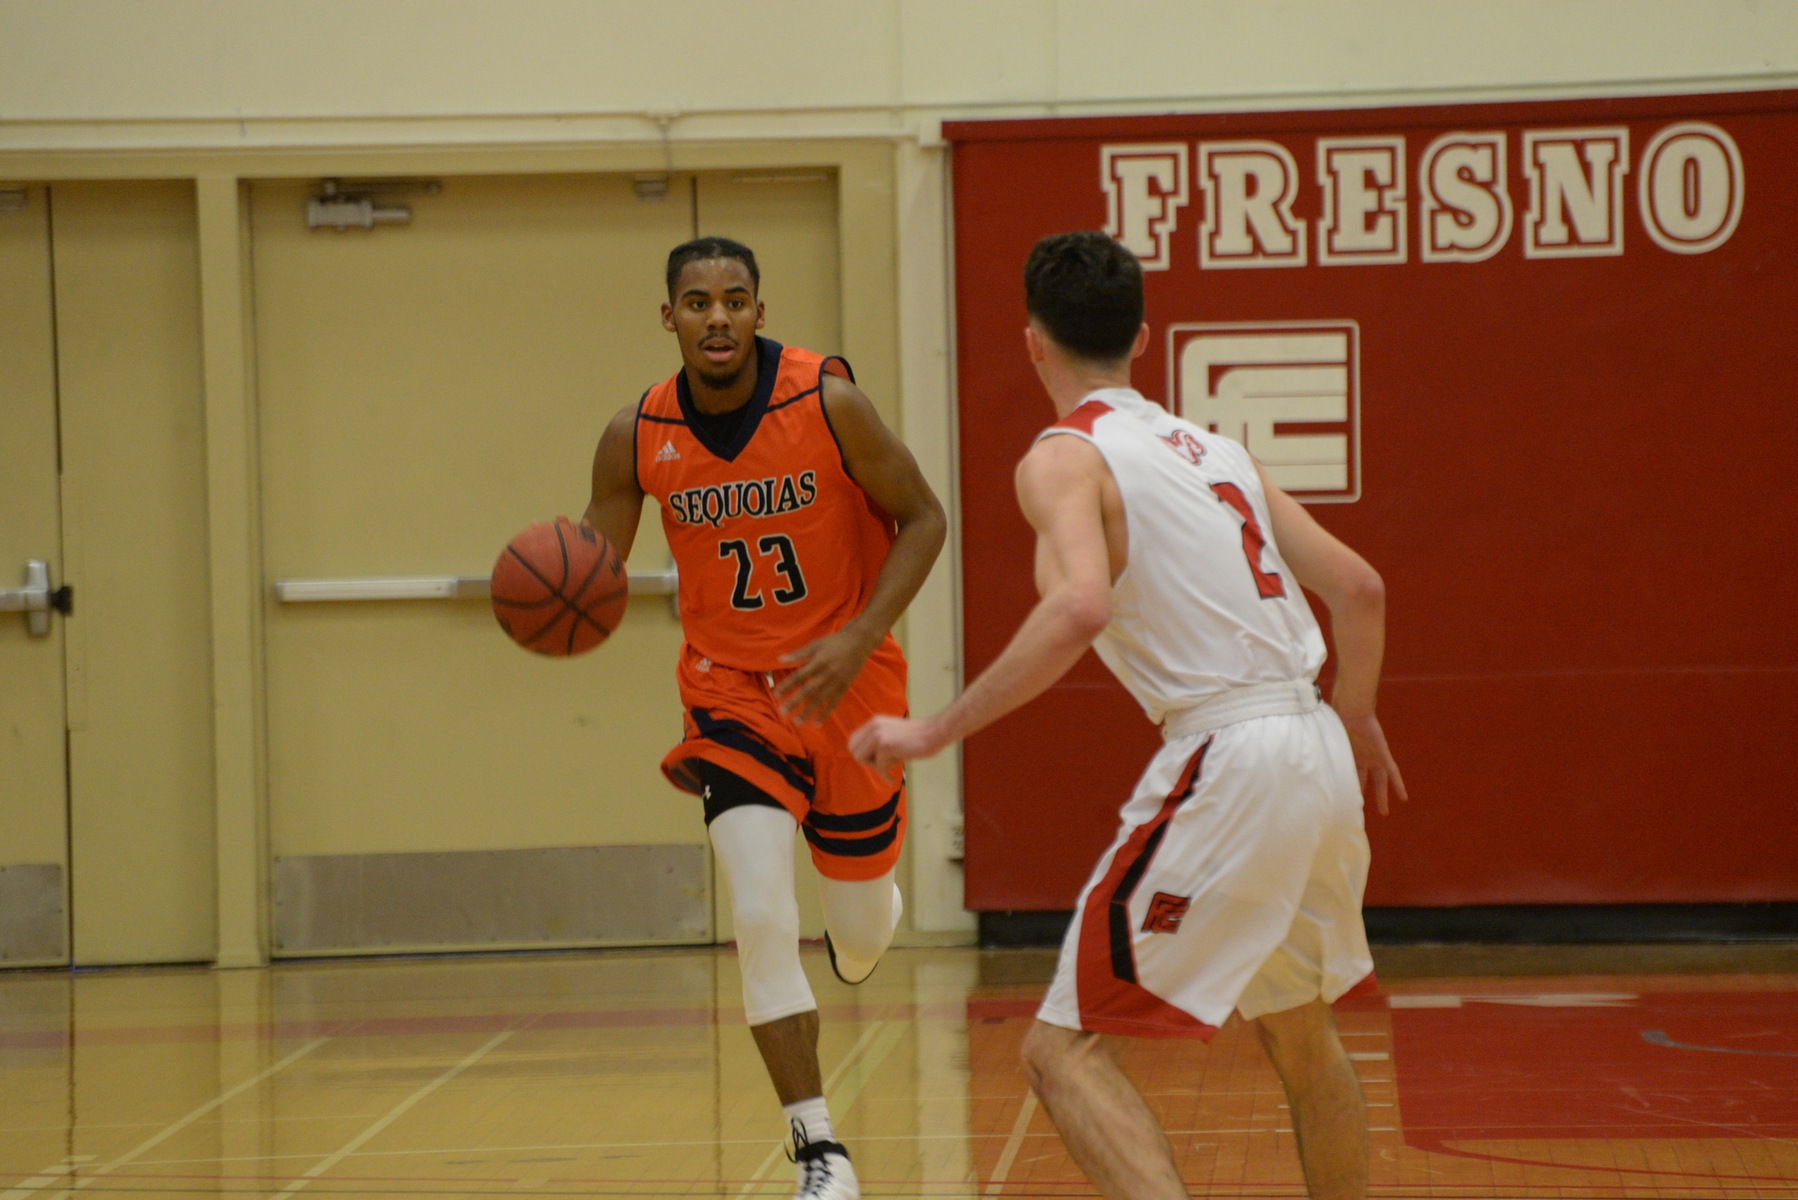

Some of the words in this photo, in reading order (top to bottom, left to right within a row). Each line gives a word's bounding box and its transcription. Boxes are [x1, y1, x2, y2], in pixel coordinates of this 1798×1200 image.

[1101, 122, 1745, 271] FRESNO
[669, 471, 817, 528] SEQUOIAS
[1208, 482, 1287, 600] 2
[718, 533, 808, 611] 23
